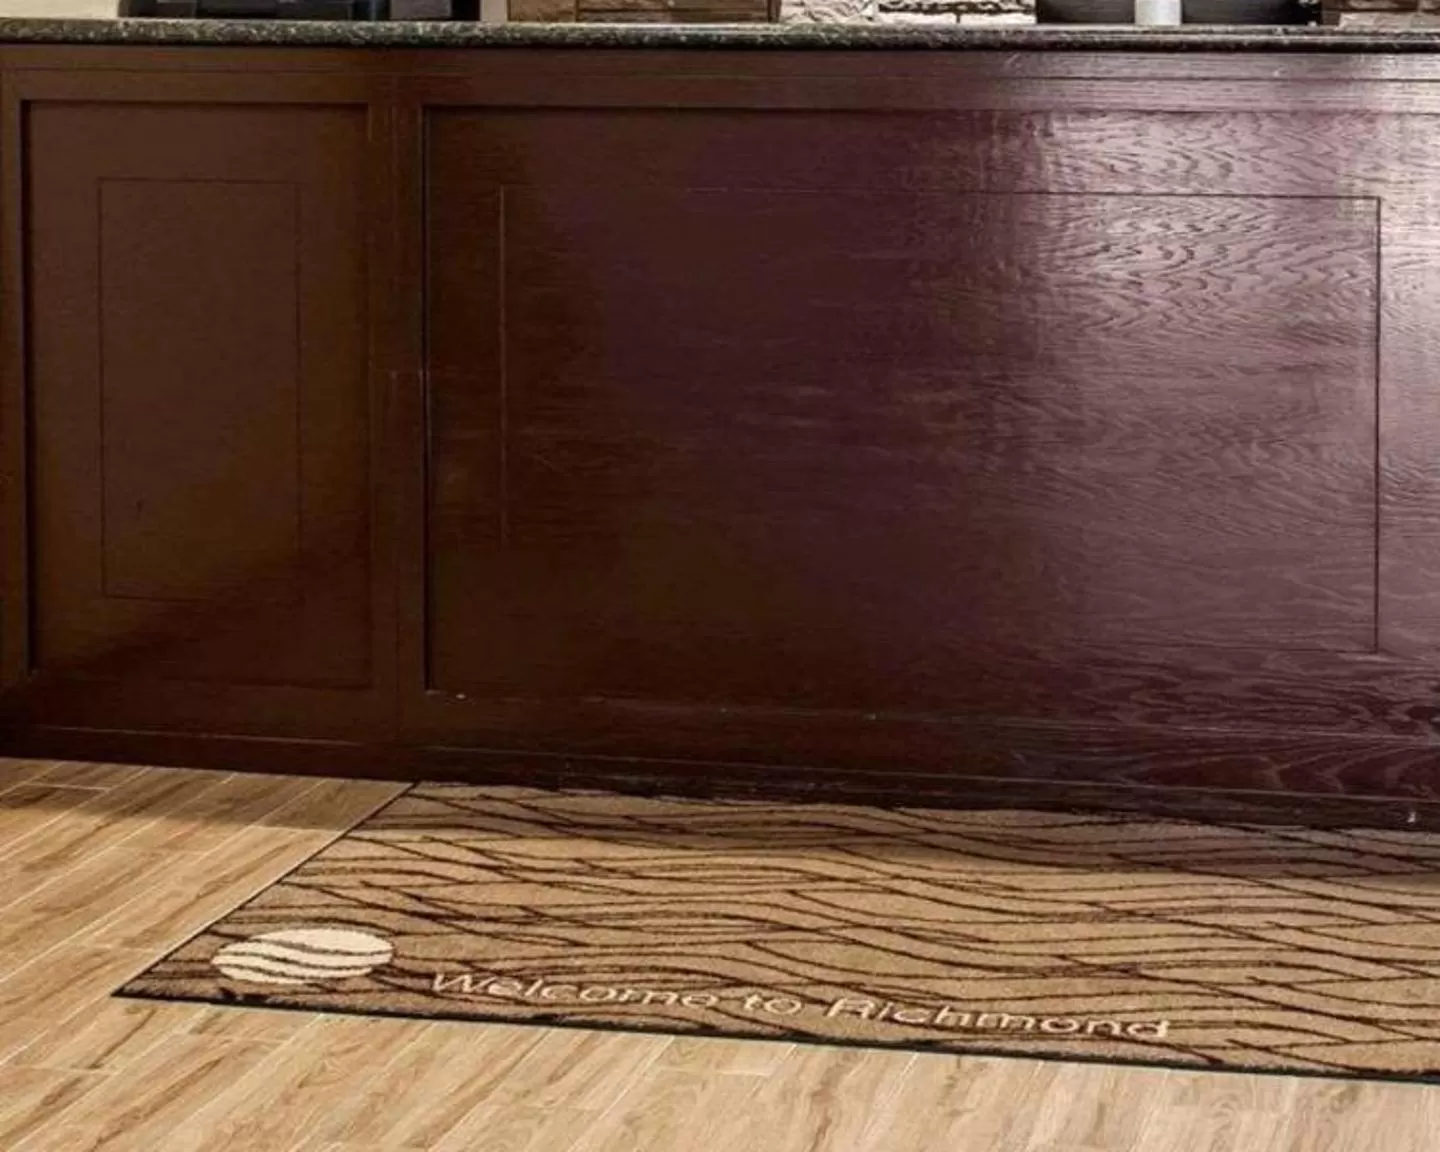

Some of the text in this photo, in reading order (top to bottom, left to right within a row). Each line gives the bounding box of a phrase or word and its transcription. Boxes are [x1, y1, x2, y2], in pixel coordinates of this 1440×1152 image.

[432, 973, 1172, 1038] Welcome to Richmond
